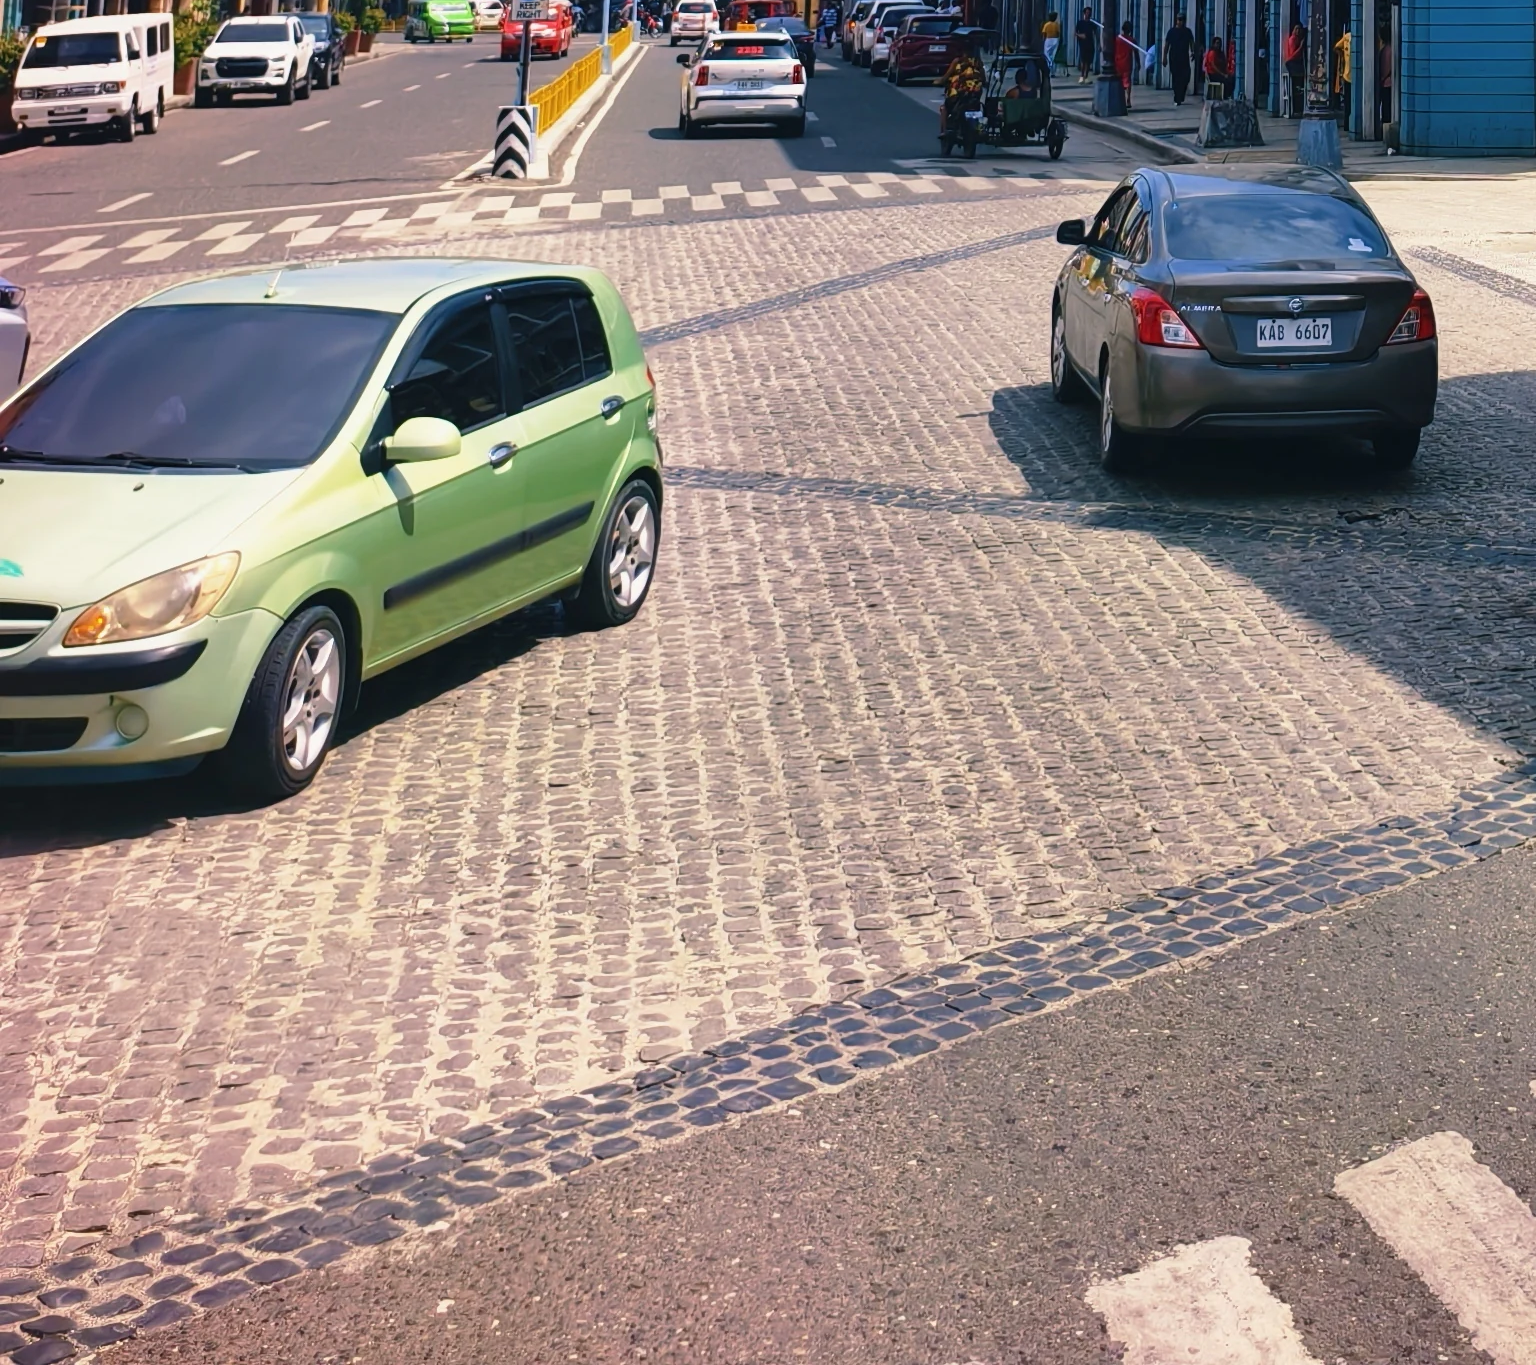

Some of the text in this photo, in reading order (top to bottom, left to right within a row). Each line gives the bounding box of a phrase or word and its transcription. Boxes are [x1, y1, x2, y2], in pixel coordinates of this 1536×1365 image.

[519, 1, 541, 10] KEEP
[516, 10, 542, 19] RIGHT
[1259, 324, 1330, 341] KAB 6607
